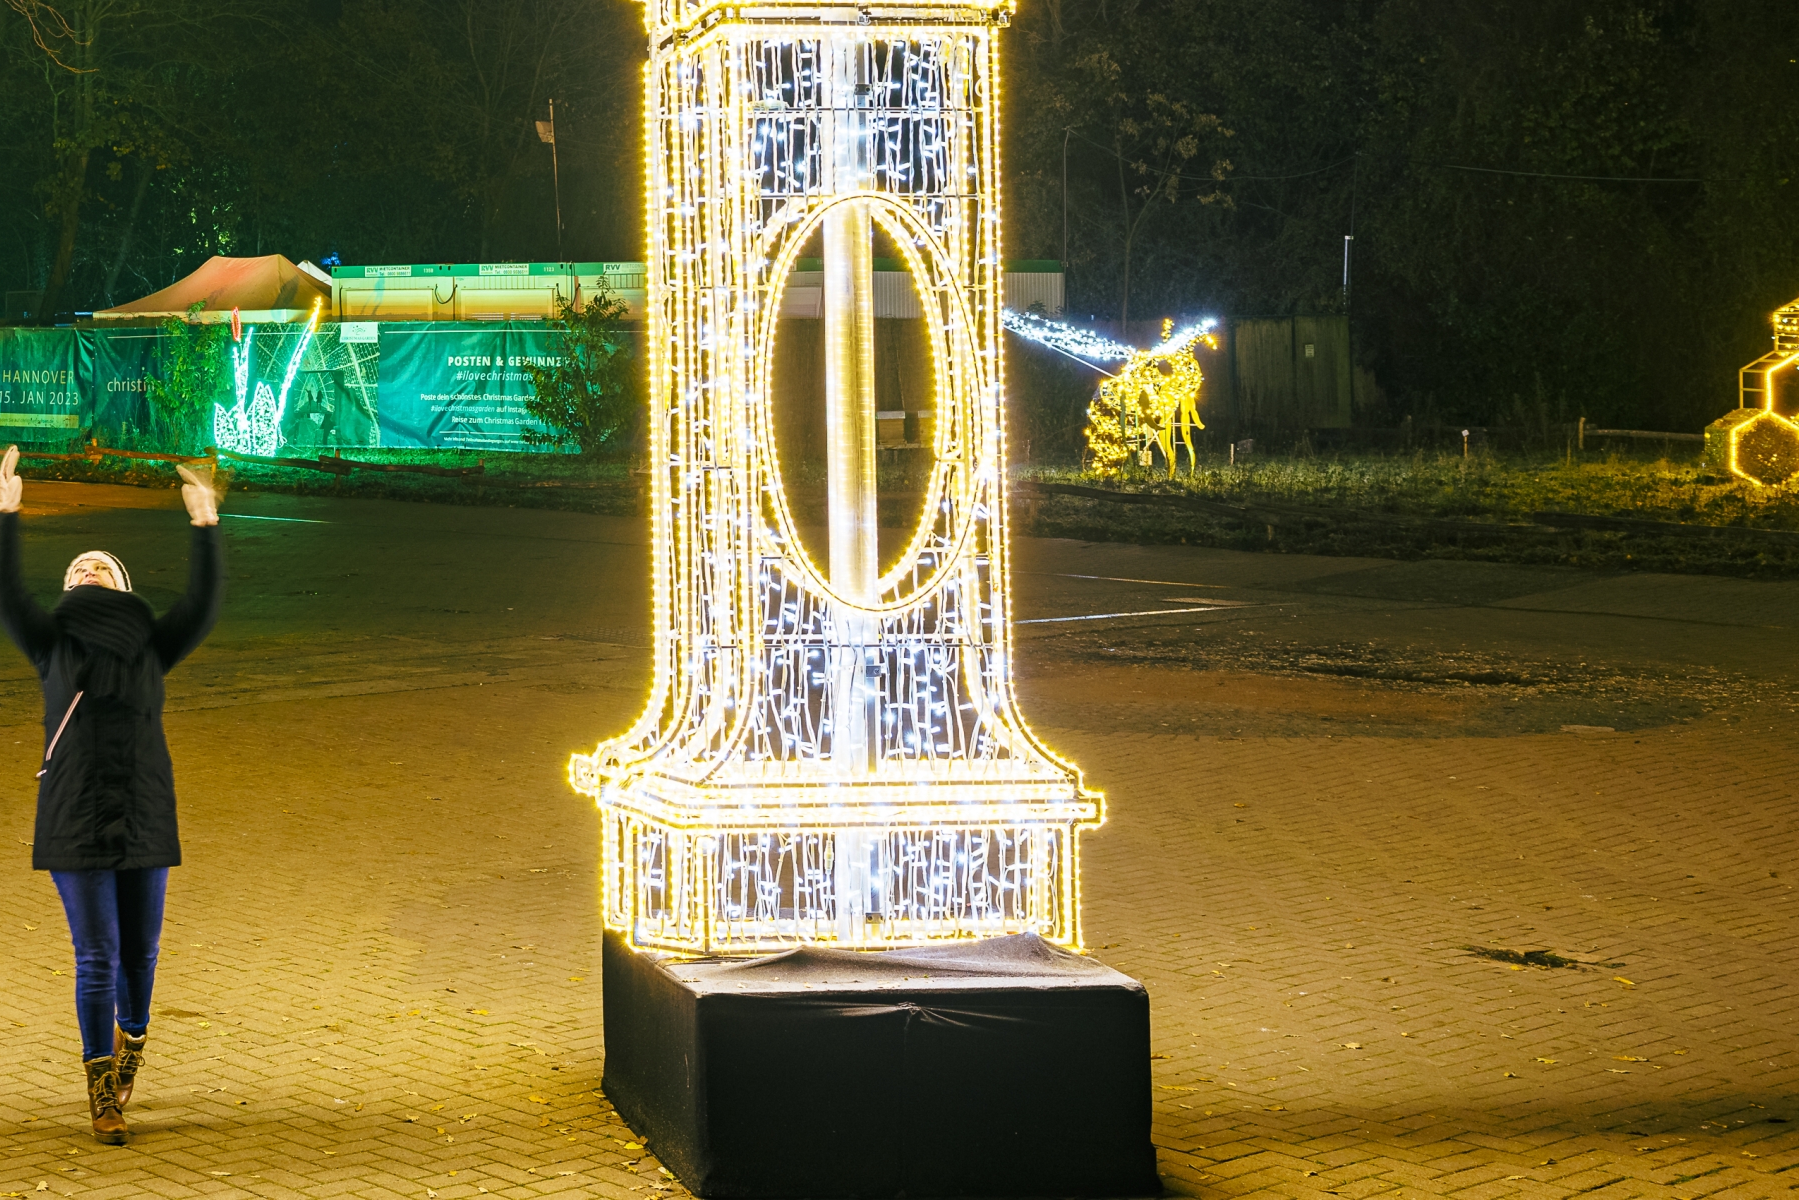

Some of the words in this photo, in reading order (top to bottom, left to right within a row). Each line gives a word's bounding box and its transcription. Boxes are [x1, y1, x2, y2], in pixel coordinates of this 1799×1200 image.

[448, 356, 491, 367] POSTEN
[495, 356, 504, 367] &
[2, 369, 74, 384] HANNOVER
[456, 371, 533, 381] #ilovechristmas
[0, 390, 15, 404] 15.
[20, 391, 44, 405] JAN
[49, 391, 79, 406] 2023
[420, 393, 436, 401] Poste
[436, 393, 449, 401] dein
[450, 393, 481, 401] schönstes
[483, 393, 513, 401] Christmas
[451, 415, 468, 423] Reise
[484, 417, 514, 425] Christmas
